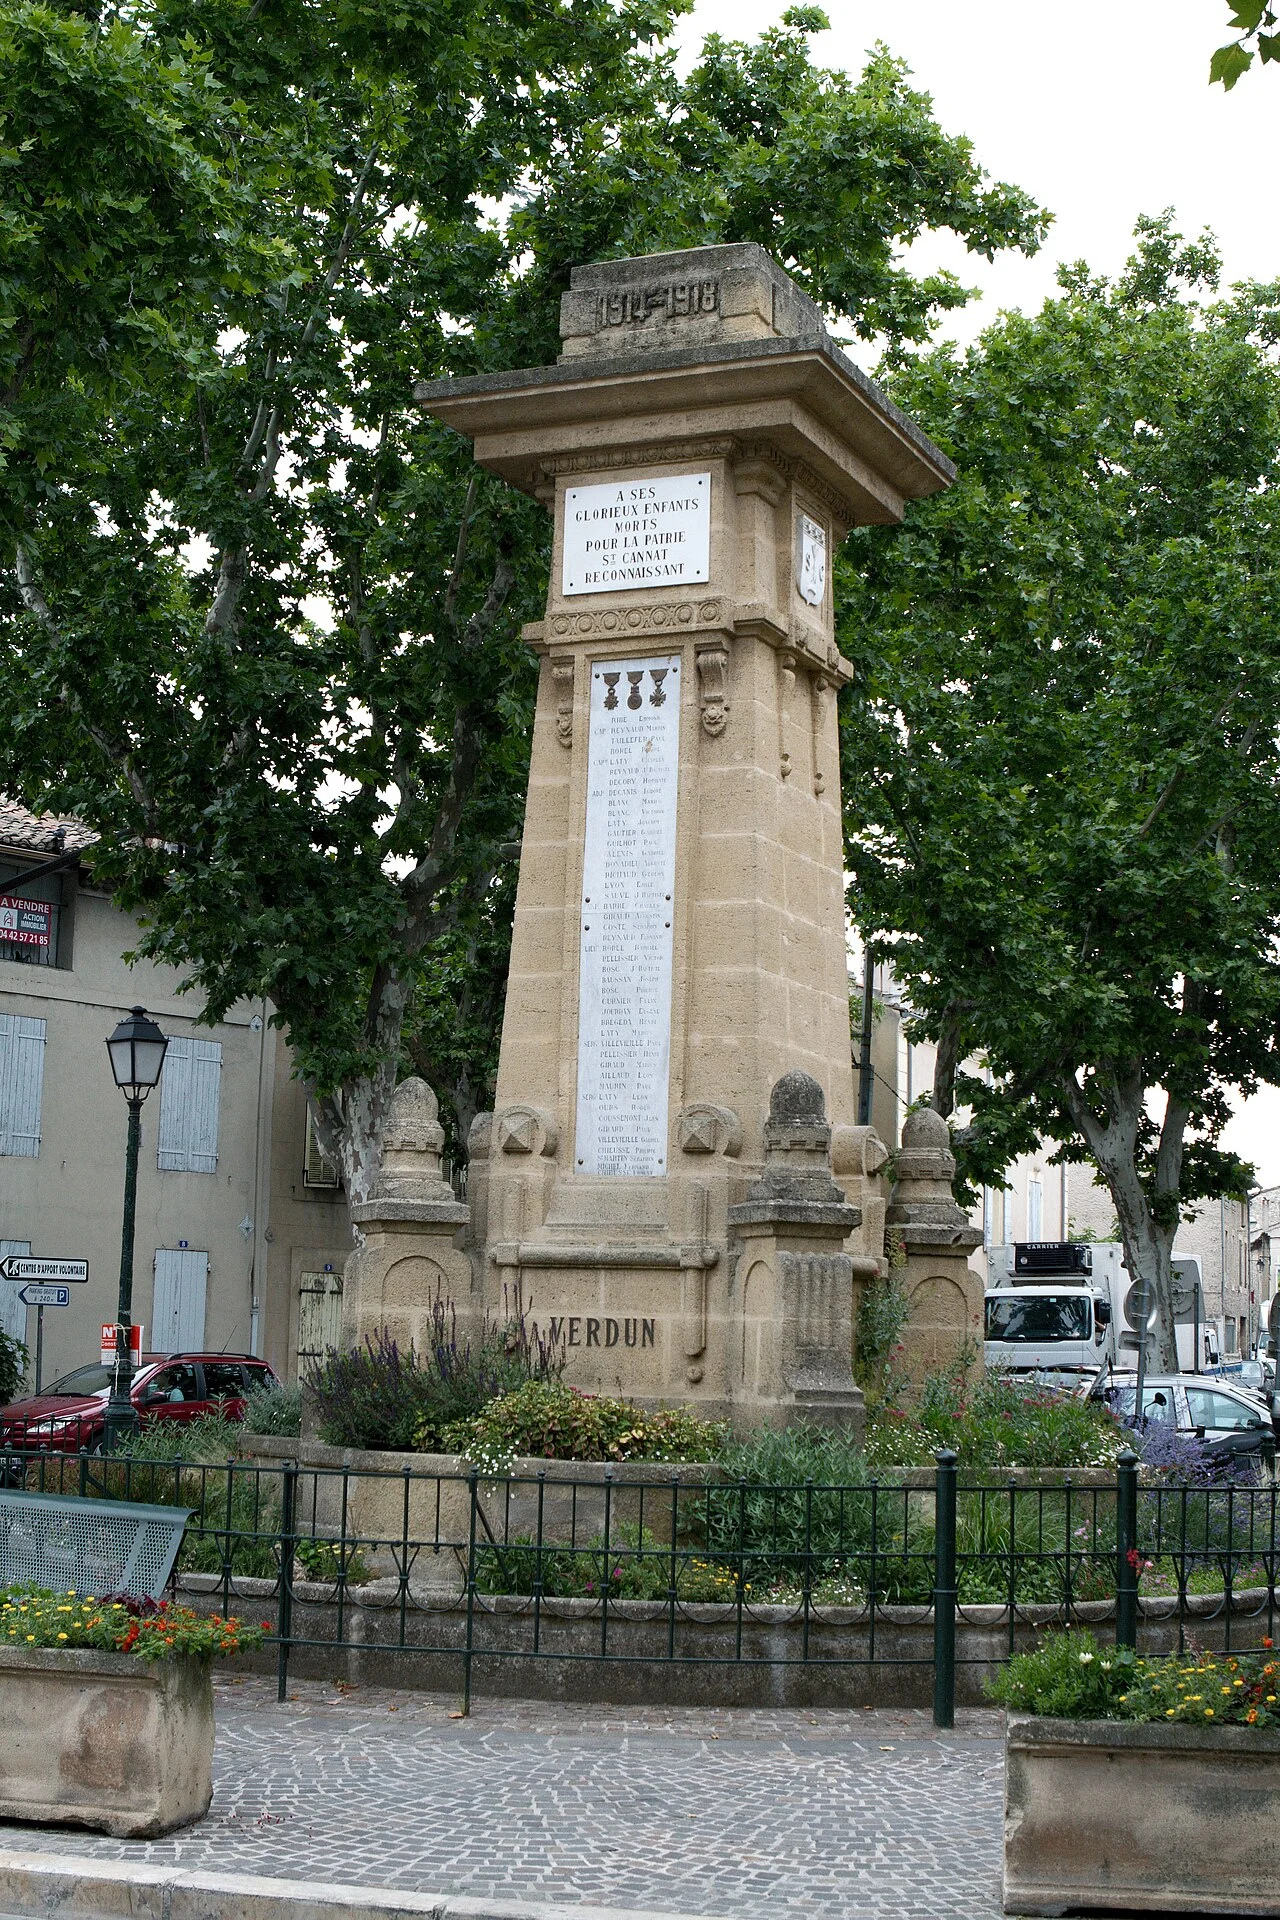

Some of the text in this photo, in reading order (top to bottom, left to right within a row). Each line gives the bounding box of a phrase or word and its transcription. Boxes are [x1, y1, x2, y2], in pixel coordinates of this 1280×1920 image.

[617, 487, 656, 502] A SES
[575, 499, 699, 522] GLORIEUX ENFANTS
[615, 519, 657, 534] MORTS
[586, 531, 686, 552] POUR LA PATRIE
[622, 549, 668, 563] CANNAT
[585, 563, 684, 583] RECONNAISSANT
[608, 829, 637, 837] GAUTIER
[1, 898, 49, 914] A VENDRE
[23, 913, 45, 922] ACTION
[20, 920, 47, 930] IMMOBILIER
[9, 931, 18, 940] 42
[20, 932, 28, 942] 57
[30, 933, 38, 944] 21
[40, 936, 48, 945] 85
[21, 1264, 85, 1275] CENTRE D'APPORT VOLONTAIRE
[60, 1292, 64, 1300] P
[550, 1317, 655, 1347] VERDUN
